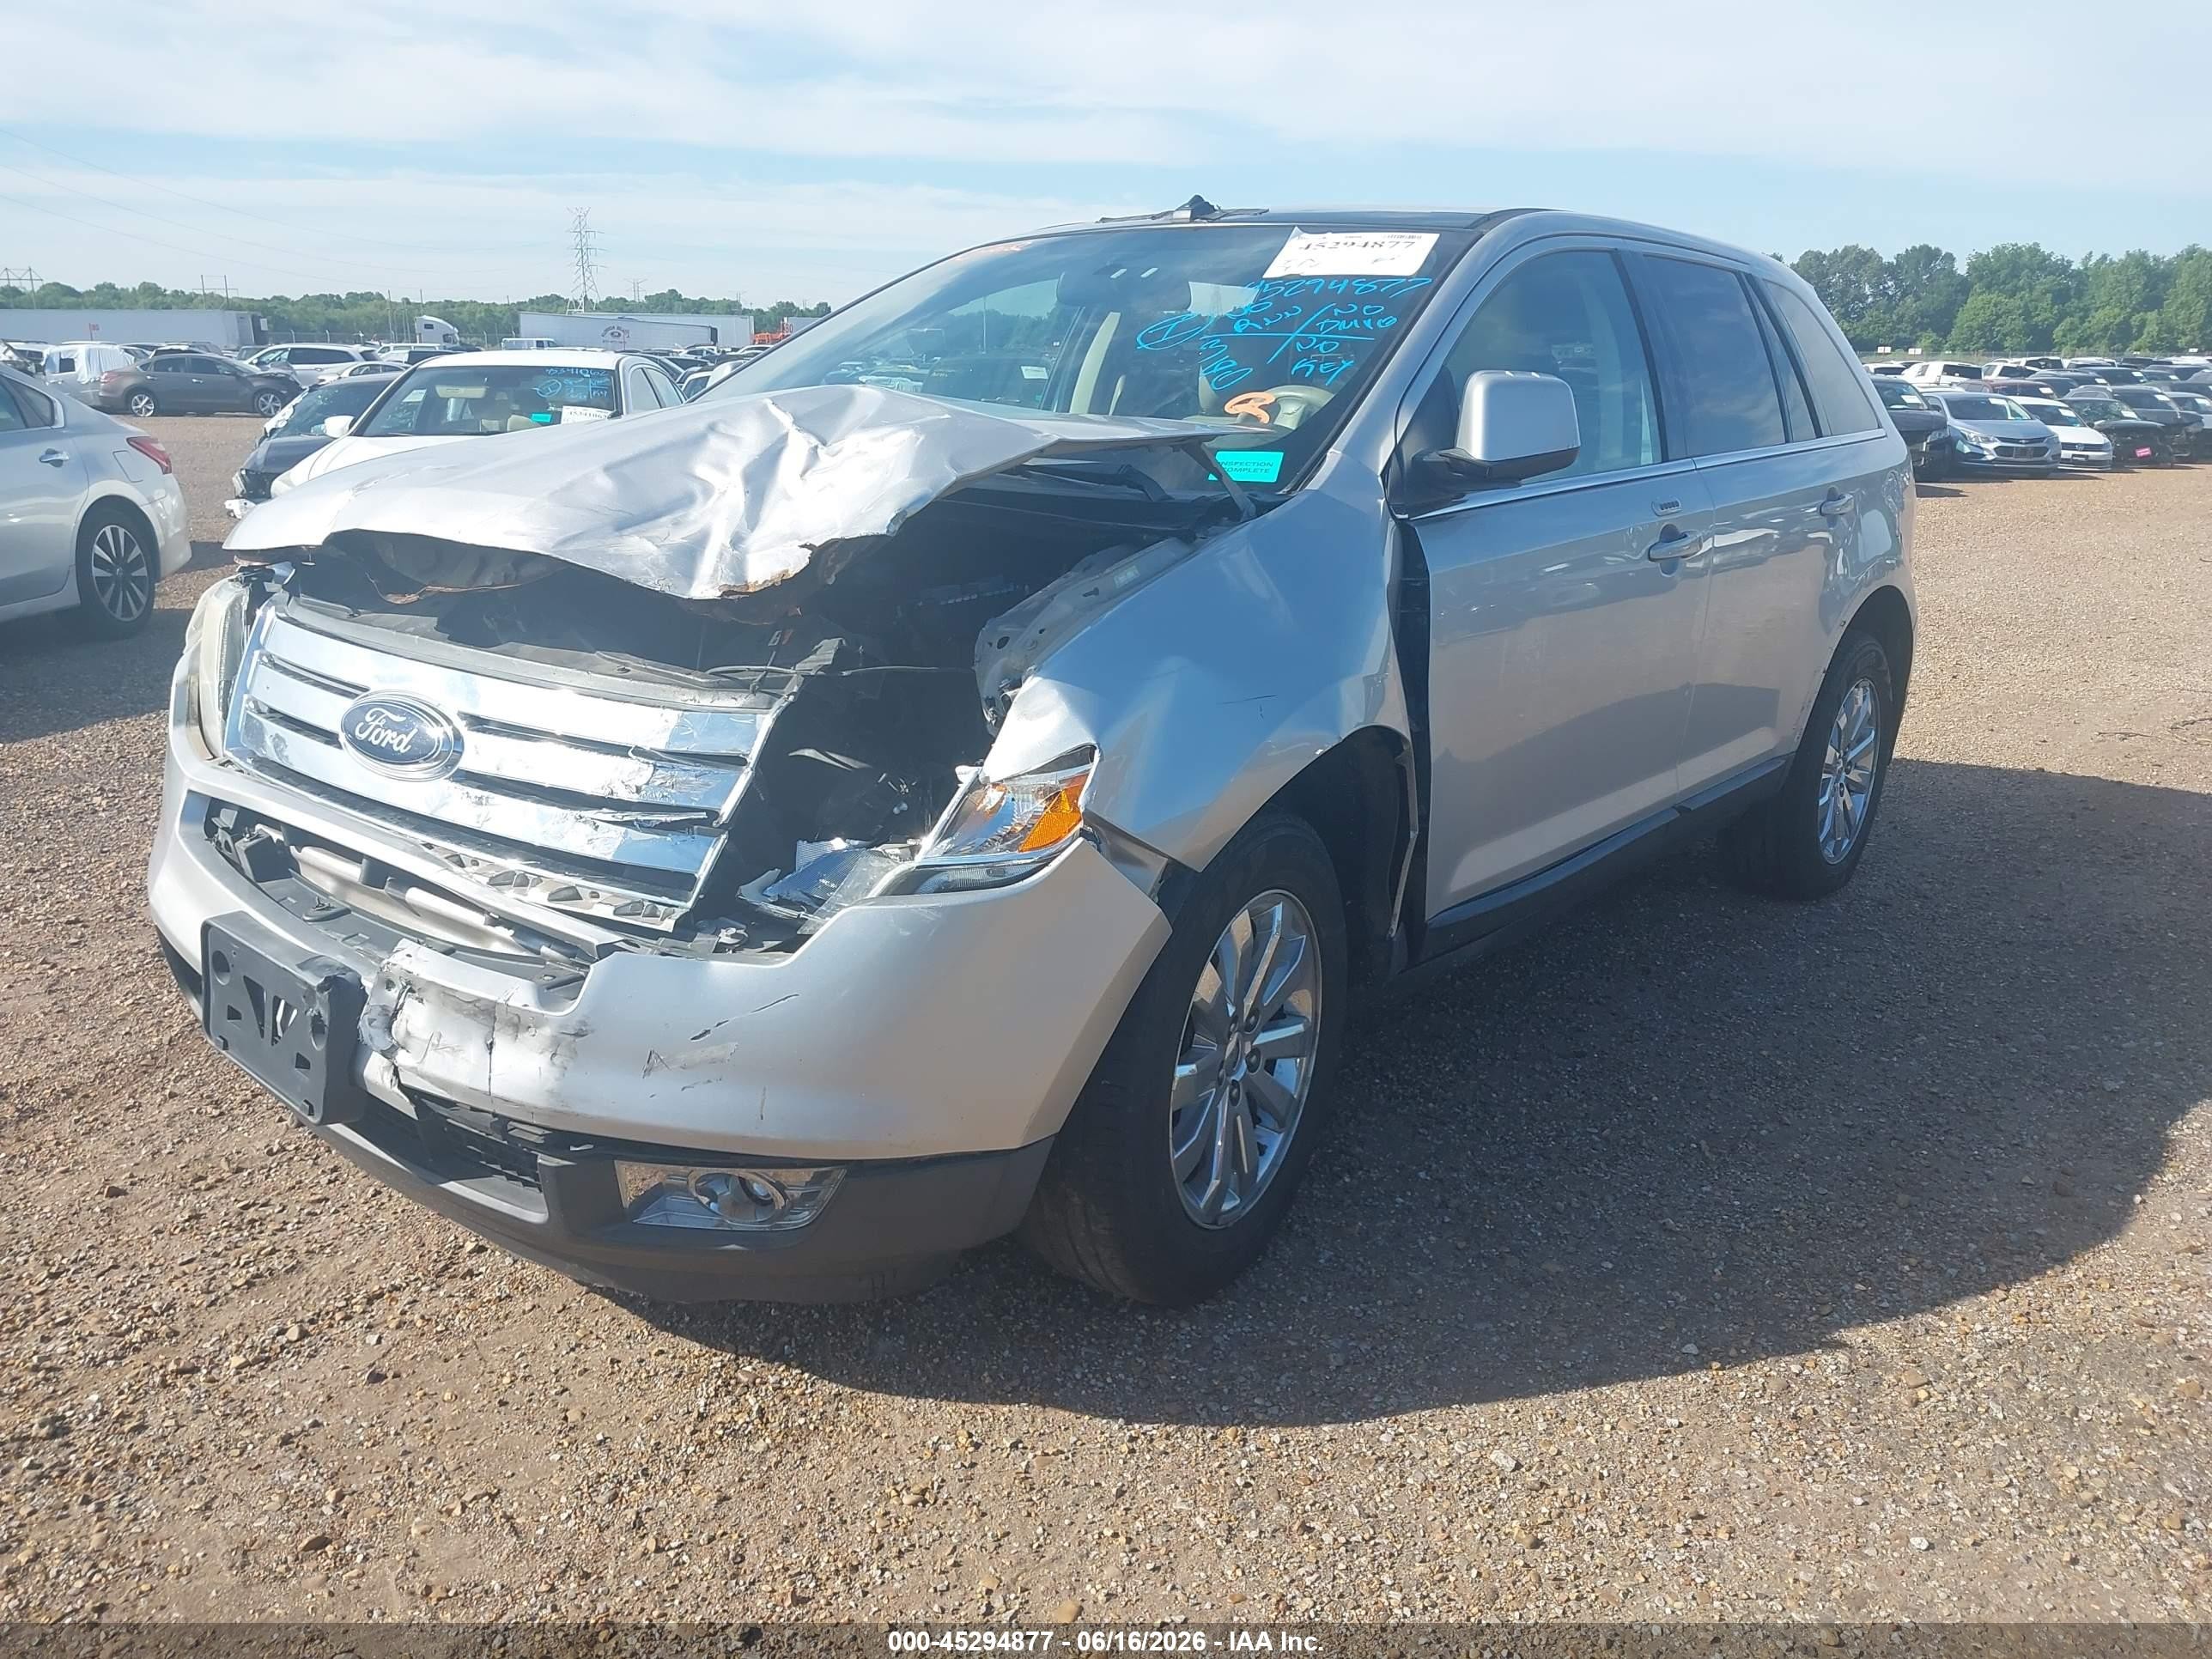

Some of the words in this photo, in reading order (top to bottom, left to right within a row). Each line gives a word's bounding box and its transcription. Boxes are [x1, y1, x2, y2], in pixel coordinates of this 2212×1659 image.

[1299, 241, 1415, 251] 45294877
[1246, 278, 1432, 301] 45294877
[1334, 303, 1384, 316] NO
[1297, 337, 1340, 353] NO
[356, 708, 419, 753] Ford
